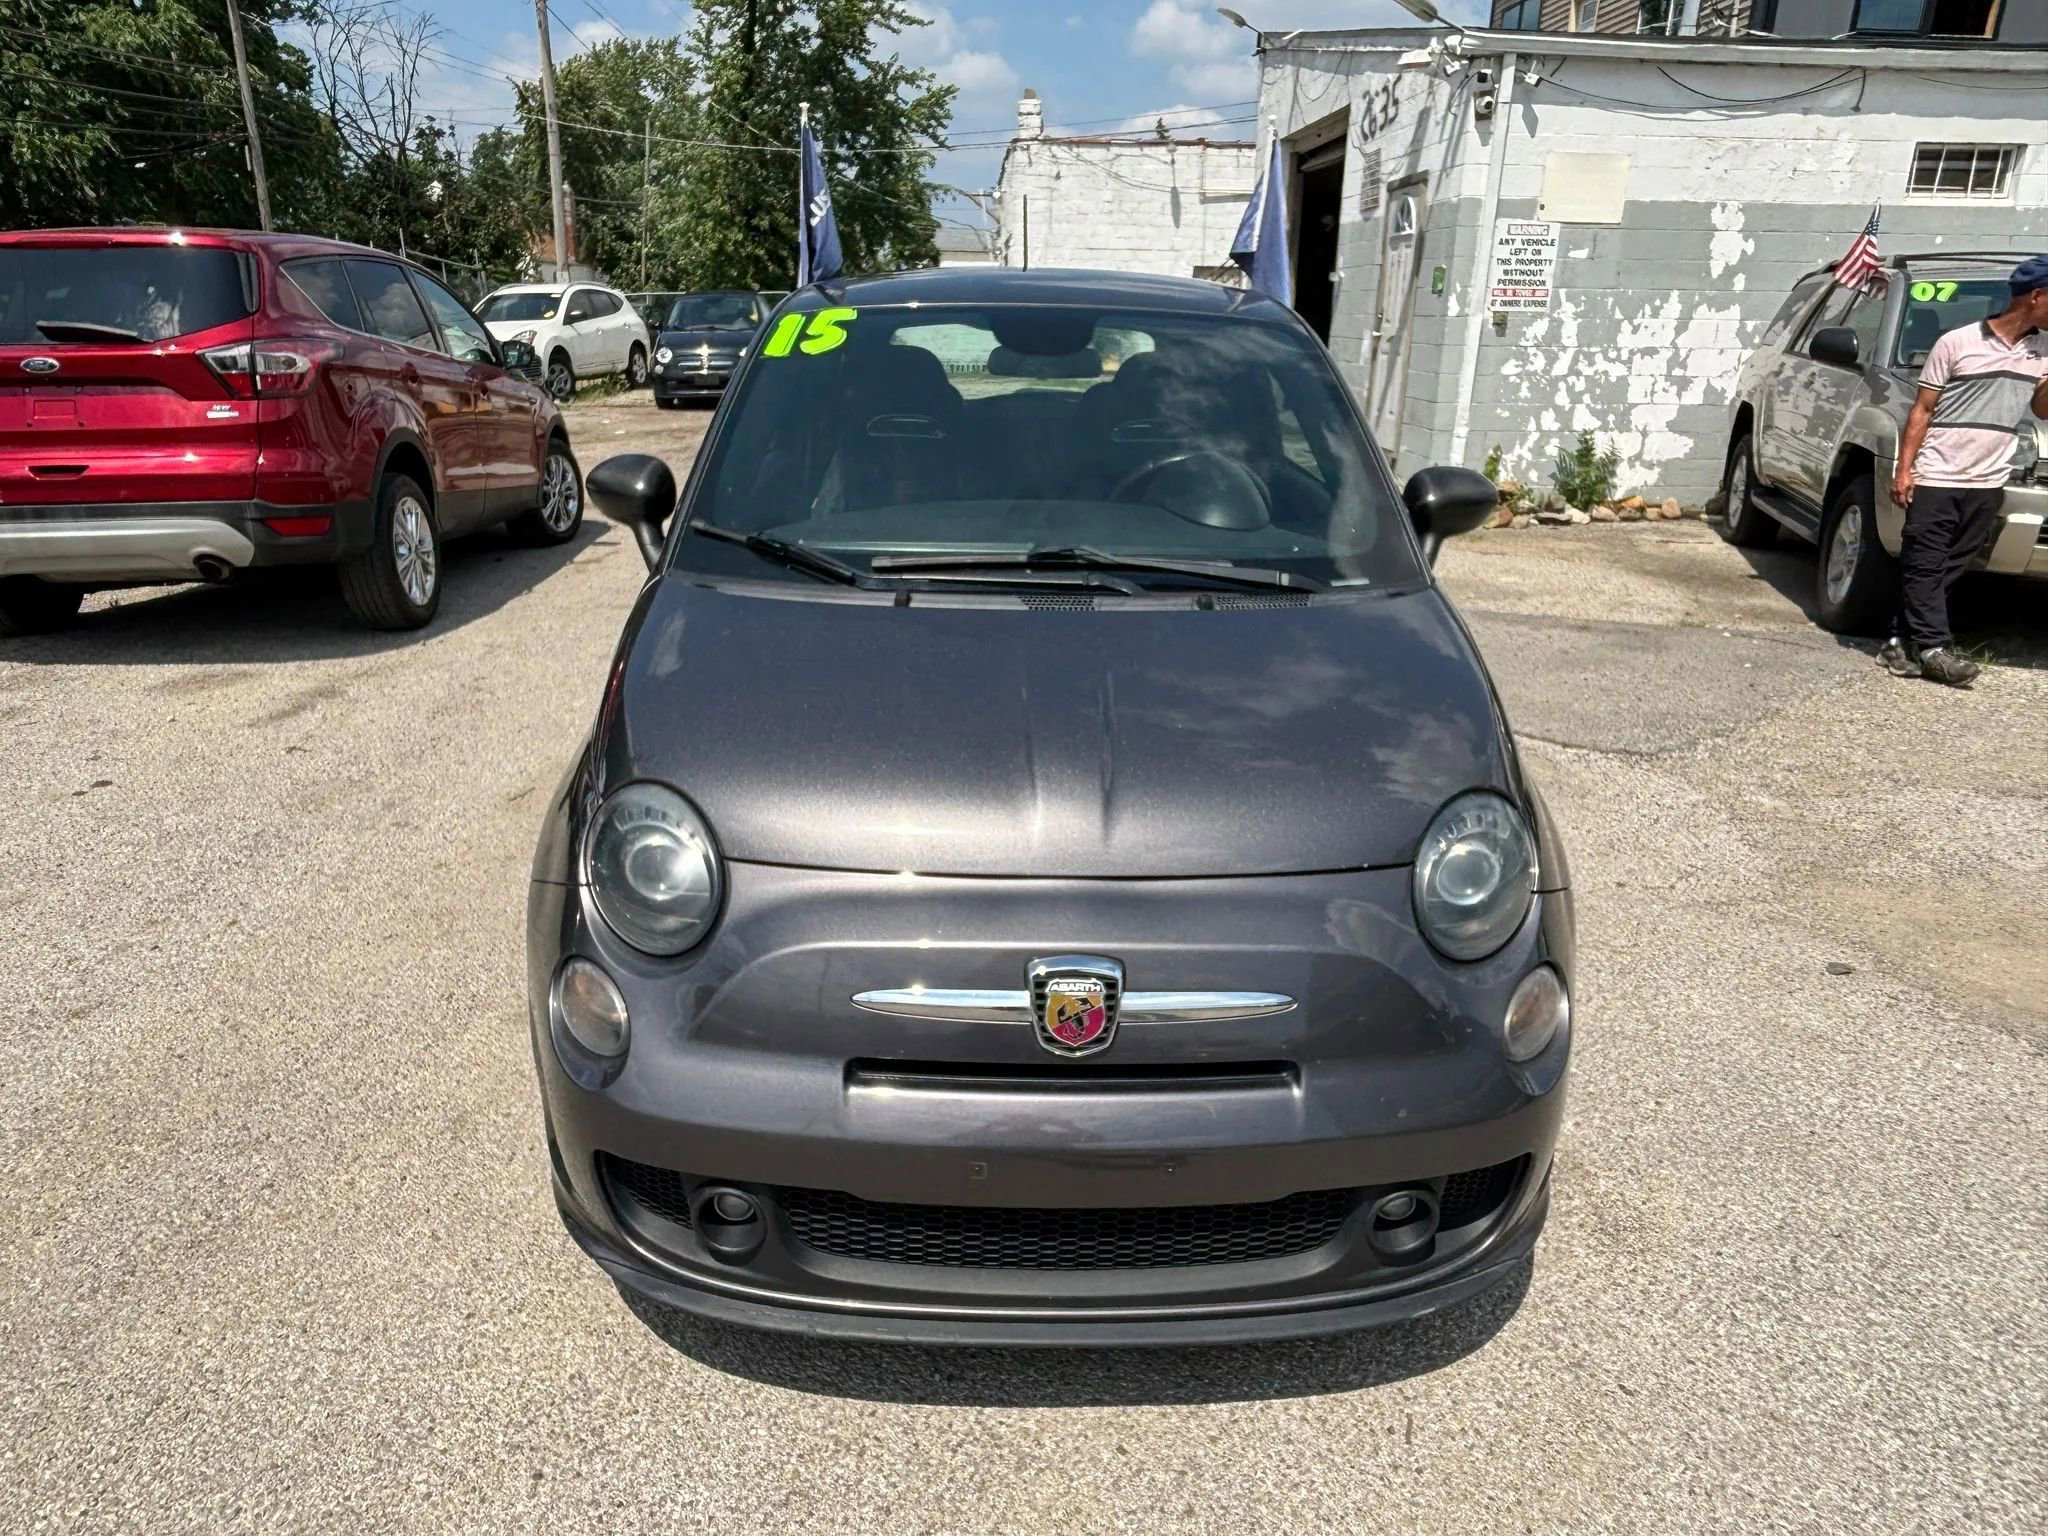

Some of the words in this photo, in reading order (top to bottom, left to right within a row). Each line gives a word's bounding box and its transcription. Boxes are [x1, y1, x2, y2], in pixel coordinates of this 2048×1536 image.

[1499, 238, 1516, 246] ANY
[1521, 238, 1556, 247] VEHICLE
[1510, 248, 1528, 256] LEFT
[1532, 248, 1542, 256] ON
[1497, 258, 1512, 266] THIS
[1515, 259, 1553, 267] PROPERTY
[1503, 269, 1544, 277] WITHOUT
[1497, 279, 1546, 287] PERMISSION
[1910, 281, 1958, 302] 07
[1524, 300, 1547, 308] EXPENSE
[763, 308, 858, 357] 15
[1050, 983, 1101, 992] ABARTH
